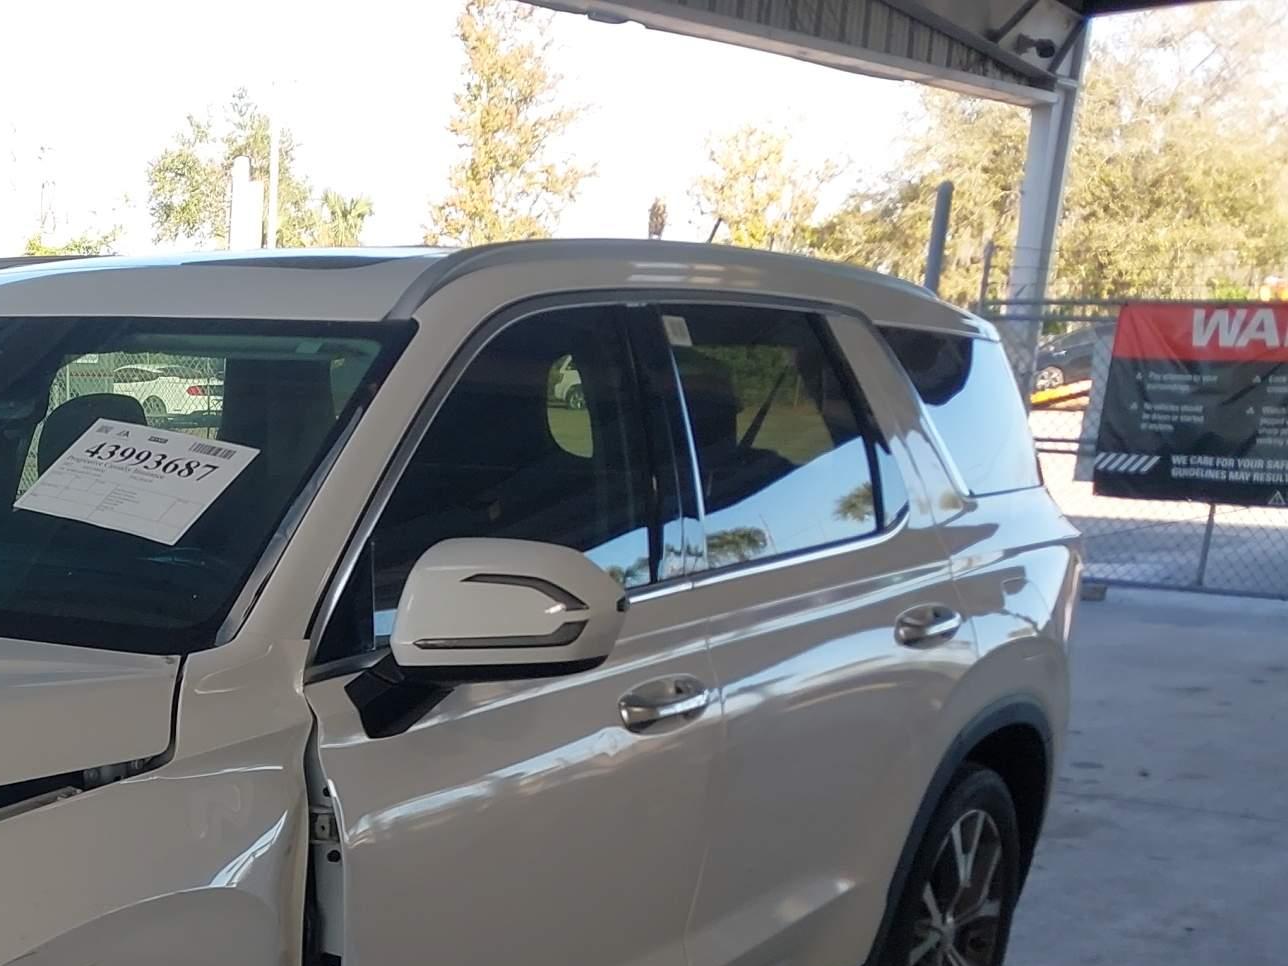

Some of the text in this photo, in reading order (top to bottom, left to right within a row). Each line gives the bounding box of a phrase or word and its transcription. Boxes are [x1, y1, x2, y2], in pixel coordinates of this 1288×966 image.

[1192, 308, 1288, 347] WA
[85, 442, 219, 481] 43993687
[1171, 467, 1227, 480] GUIDELINES
[1229, 471, 1251, 481] MAY
[1172, 455, 1188, 465] WE
[1190, 455, 1214, 467] CARE
[1216, 457, 1235, 468] FOR
[1237, 458, 1264, 469] YOUR
